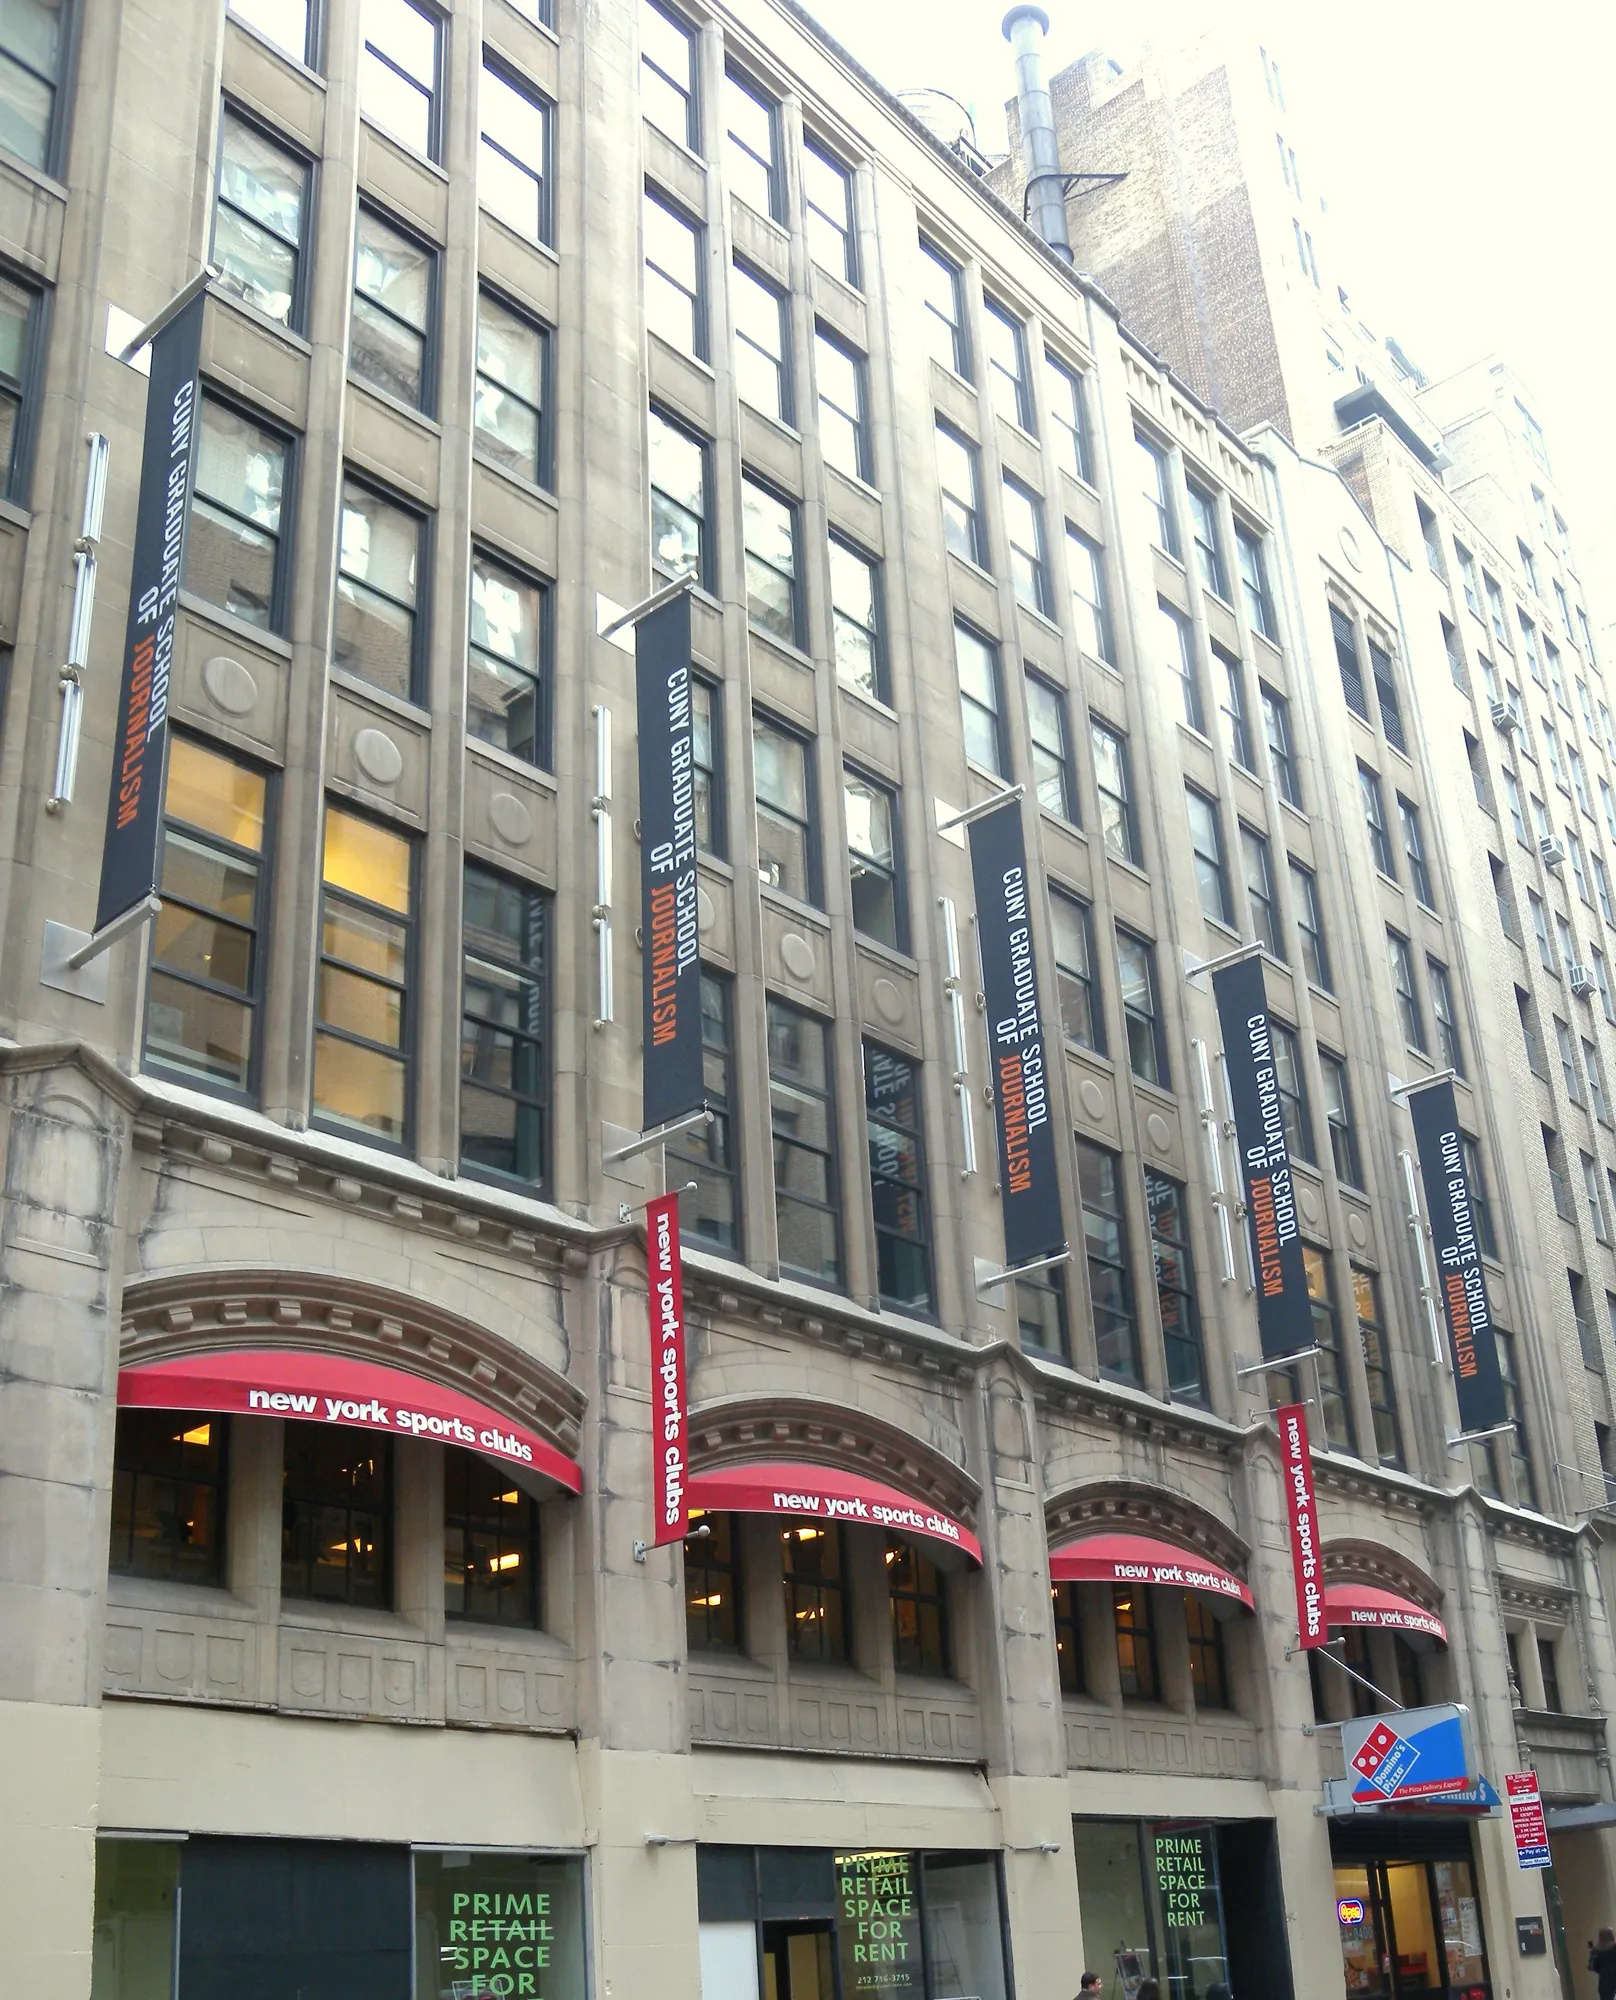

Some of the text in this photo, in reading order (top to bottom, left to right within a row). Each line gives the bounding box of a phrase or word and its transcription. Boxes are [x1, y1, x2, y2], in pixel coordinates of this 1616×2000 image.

[147, 380, 193, 743] CUNY GRADUATE SCHOOL
[116, 585, 160, 829] OF JOURNALISM
[667, 667, 697, 976] CUNY GRADUATE SCHOOL
[650, 842, 677, 1046] OF JOURNALISM
[1002, 867, 1048, 1134] CUNY GRADUATE SCHOOL
[996, 1017, 1031, 1193] OF JOURNALISM
[1247, 1014, 1297, 1247] CUNY GRADUATE SCHOOL
[1247, 1145, 1283, 1297] OF JOURNALISM
[1440, 1131, 1488, 1335] CUNY GRADUATE SCHOOL
[1441, 1245, 1477, 1378] OF JOURNALISM
[657, 1213, 683, 1525] new york sports clubs
[249, 1389, 532, 1462] new york sports clubs
[773, 1492, 959, 1540] new york sports clubs
[1287, 1418, 1321, 1637] new york sports clubs
[1114, 1564, 1241, 1596] new york sports clubs
[1351, 1610, 1377, 1622] new
[1379, 1611, 1403, 1625] york
[1404, 1614, 1429, 1628] sports
[1373, 1743, 1406, 1786] Domino's
[1381, 1766, 1405, 1793] Pizza
[1422, 1784, 1443, 1792] Delivery
[1443, 1781, 1462, 1789] Experts
[1155, 1839, 1202, 1854] PRIME
[842, 1856, 909, 1873] PRIME
[1156, 1857, 1205, 1872] RETAIL
[841, 1878, 913, 1895] RETAIL
[1160, 1875, 1205, 1890] SPACE
[453, 1893, 550, 1915] PRIME
[845, 1899, 911, 1918] SPACE
[1169, 1893, 1200, 1908] FOR
[450, 1919, 554, 1942] RETAIL
[858, 1921, 902, 1940] FOR
[1167, 1911, 1204, 1927] RENT
[454, 1946, 550, 1970] SPACE
[854, 1943, 908, 1962] RENT
[472, 1973, 537, 1996] FOR
[858, 1974, 910, 1984] 212 716-3715
